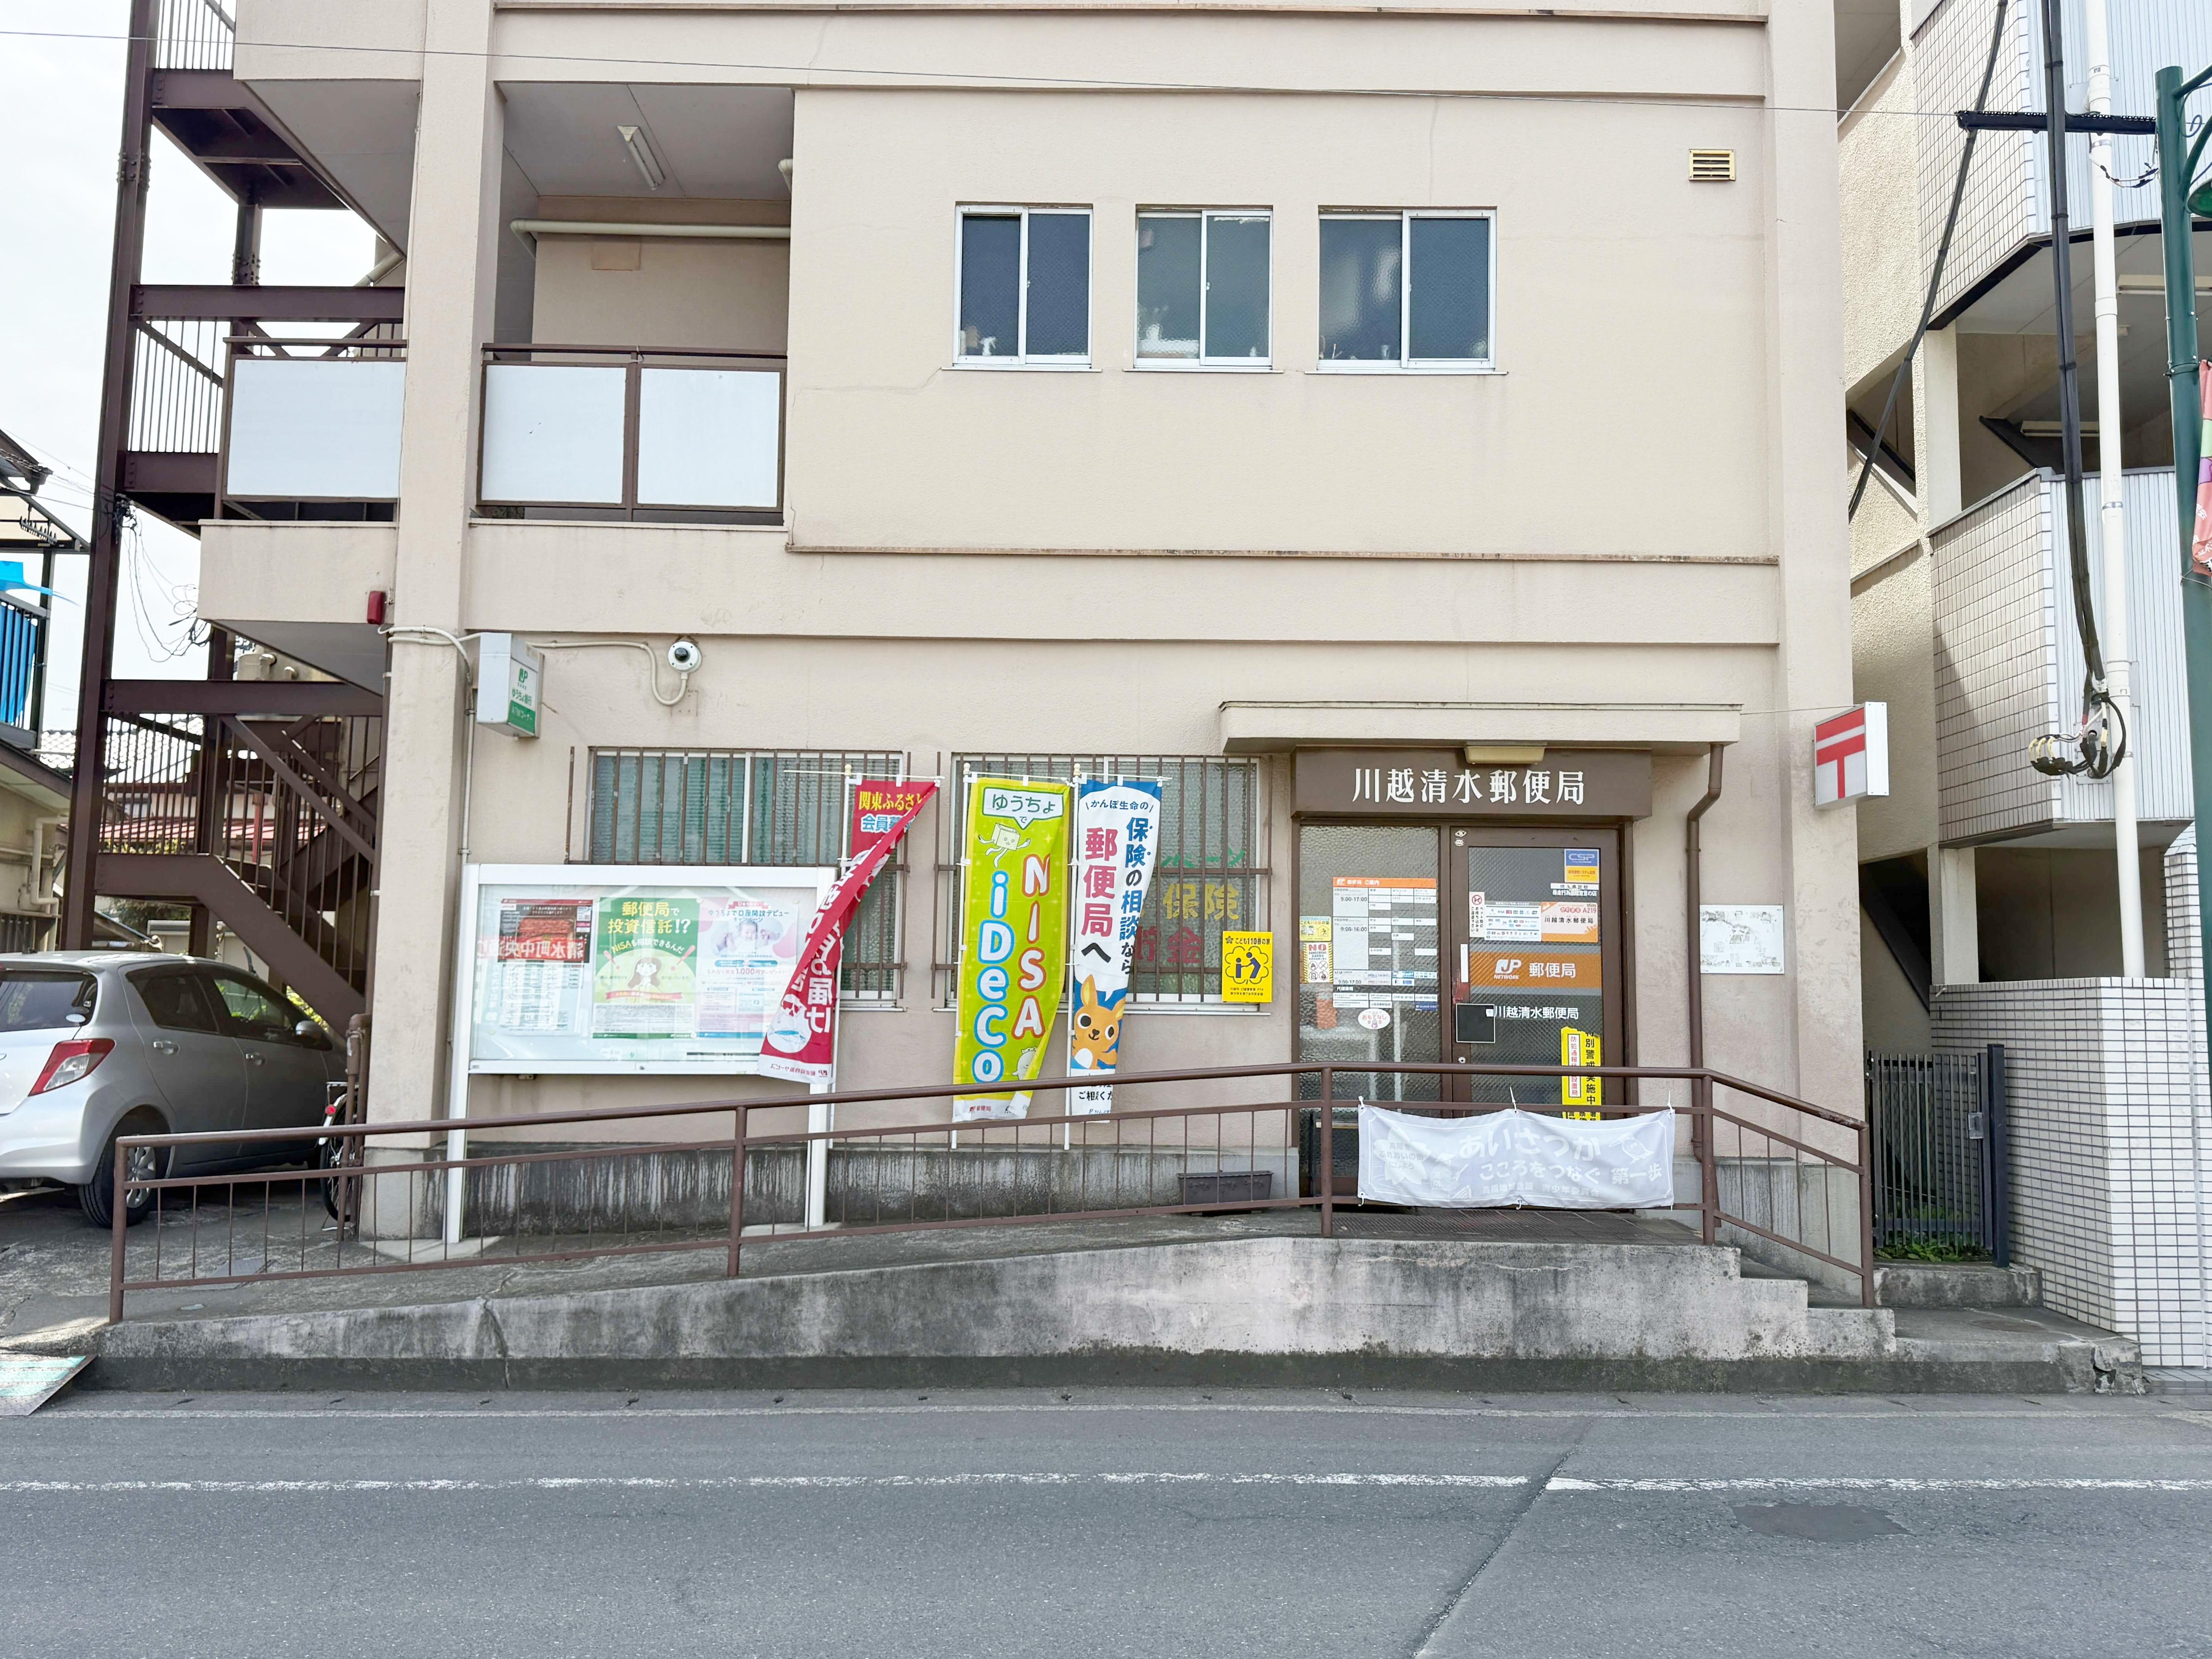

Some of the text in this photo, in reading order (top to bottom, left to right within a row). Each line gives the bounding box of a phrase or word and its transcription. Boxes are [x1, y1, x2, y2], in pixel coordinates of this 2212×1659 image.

[1352, 768, 1585, 805] 川越清水郵便局
[992, 794, 1056, 814] ゆうちょ
[1091, 799, 1149, 810] かんぽ生命の
[622, 901, 680, 917] 郵便局で
[1081, 827, 1118, 963] 郵便局へ
[1119, 817, 1150, 975] 保険の相談なら
[1163, 883, 1239, 921] 保険
[1012, 854, 1051, 1040] NISA
[972, 870, 1015, 1083] iDeCo
[1495, 959, 1576, 978] JP 郵便局
[1494, 1005, 1579, 1020] 川越清水郵便局
[1379, 1151, 1424, 1161] ふれあいの街
[1459, 1127, 1601, 1161] あいさつが
[1479, 1160, 1662, 1185] こころをつなぐ 第一歩
